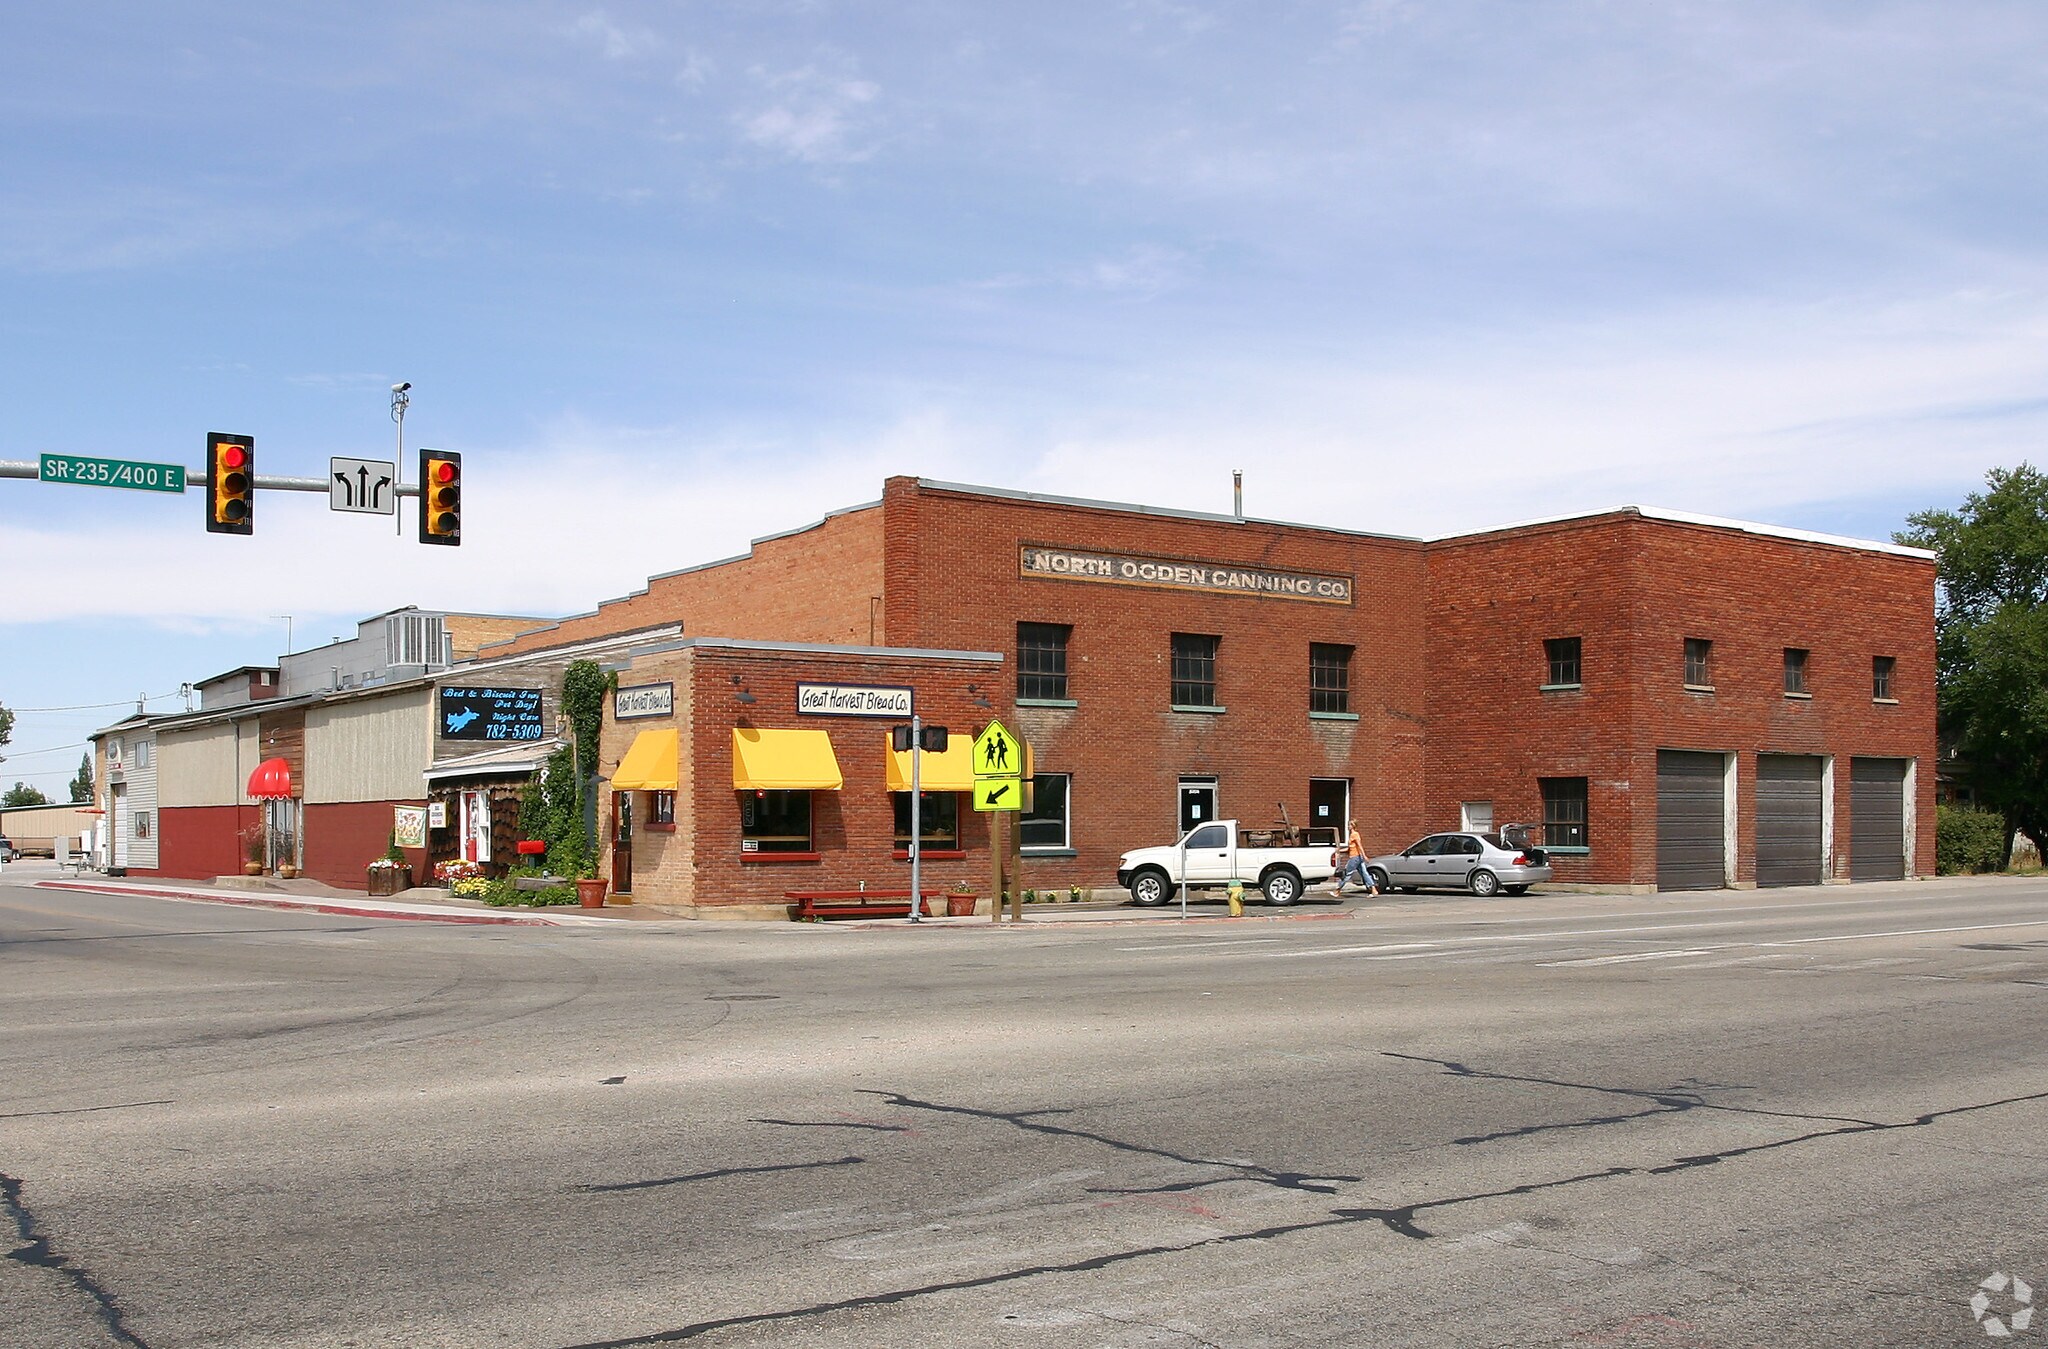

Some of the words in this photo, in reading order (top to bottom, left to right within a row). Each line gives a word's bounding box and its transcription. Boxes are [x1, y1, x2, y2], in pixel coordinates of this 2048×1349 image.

[45, 459, 158, 486] SR-235/400
[164, 470, 179, 488] E.
[1033, 553, 1112, 576] NORTH
[1121, 561, 1206, 584] OGDEN
[1211, 570, 1312, 594] CANNING
[1317, 581, 1348, 597] CO.
[443, 688, 465, 698] Bed
[468, 690, 478, 698] &
[481, 689, 516, 698] Biscuit
[801, 688, 829, 708] Great
[829, 687, 867, 709] Harvest
[866, 692, 895, 710] Bread
[494, 700, 511, 708] Pet
[492, 712, 516, 723] Night
[519, 712, 540, 721] Care
[486, 724, 542, 740] 782-5309
